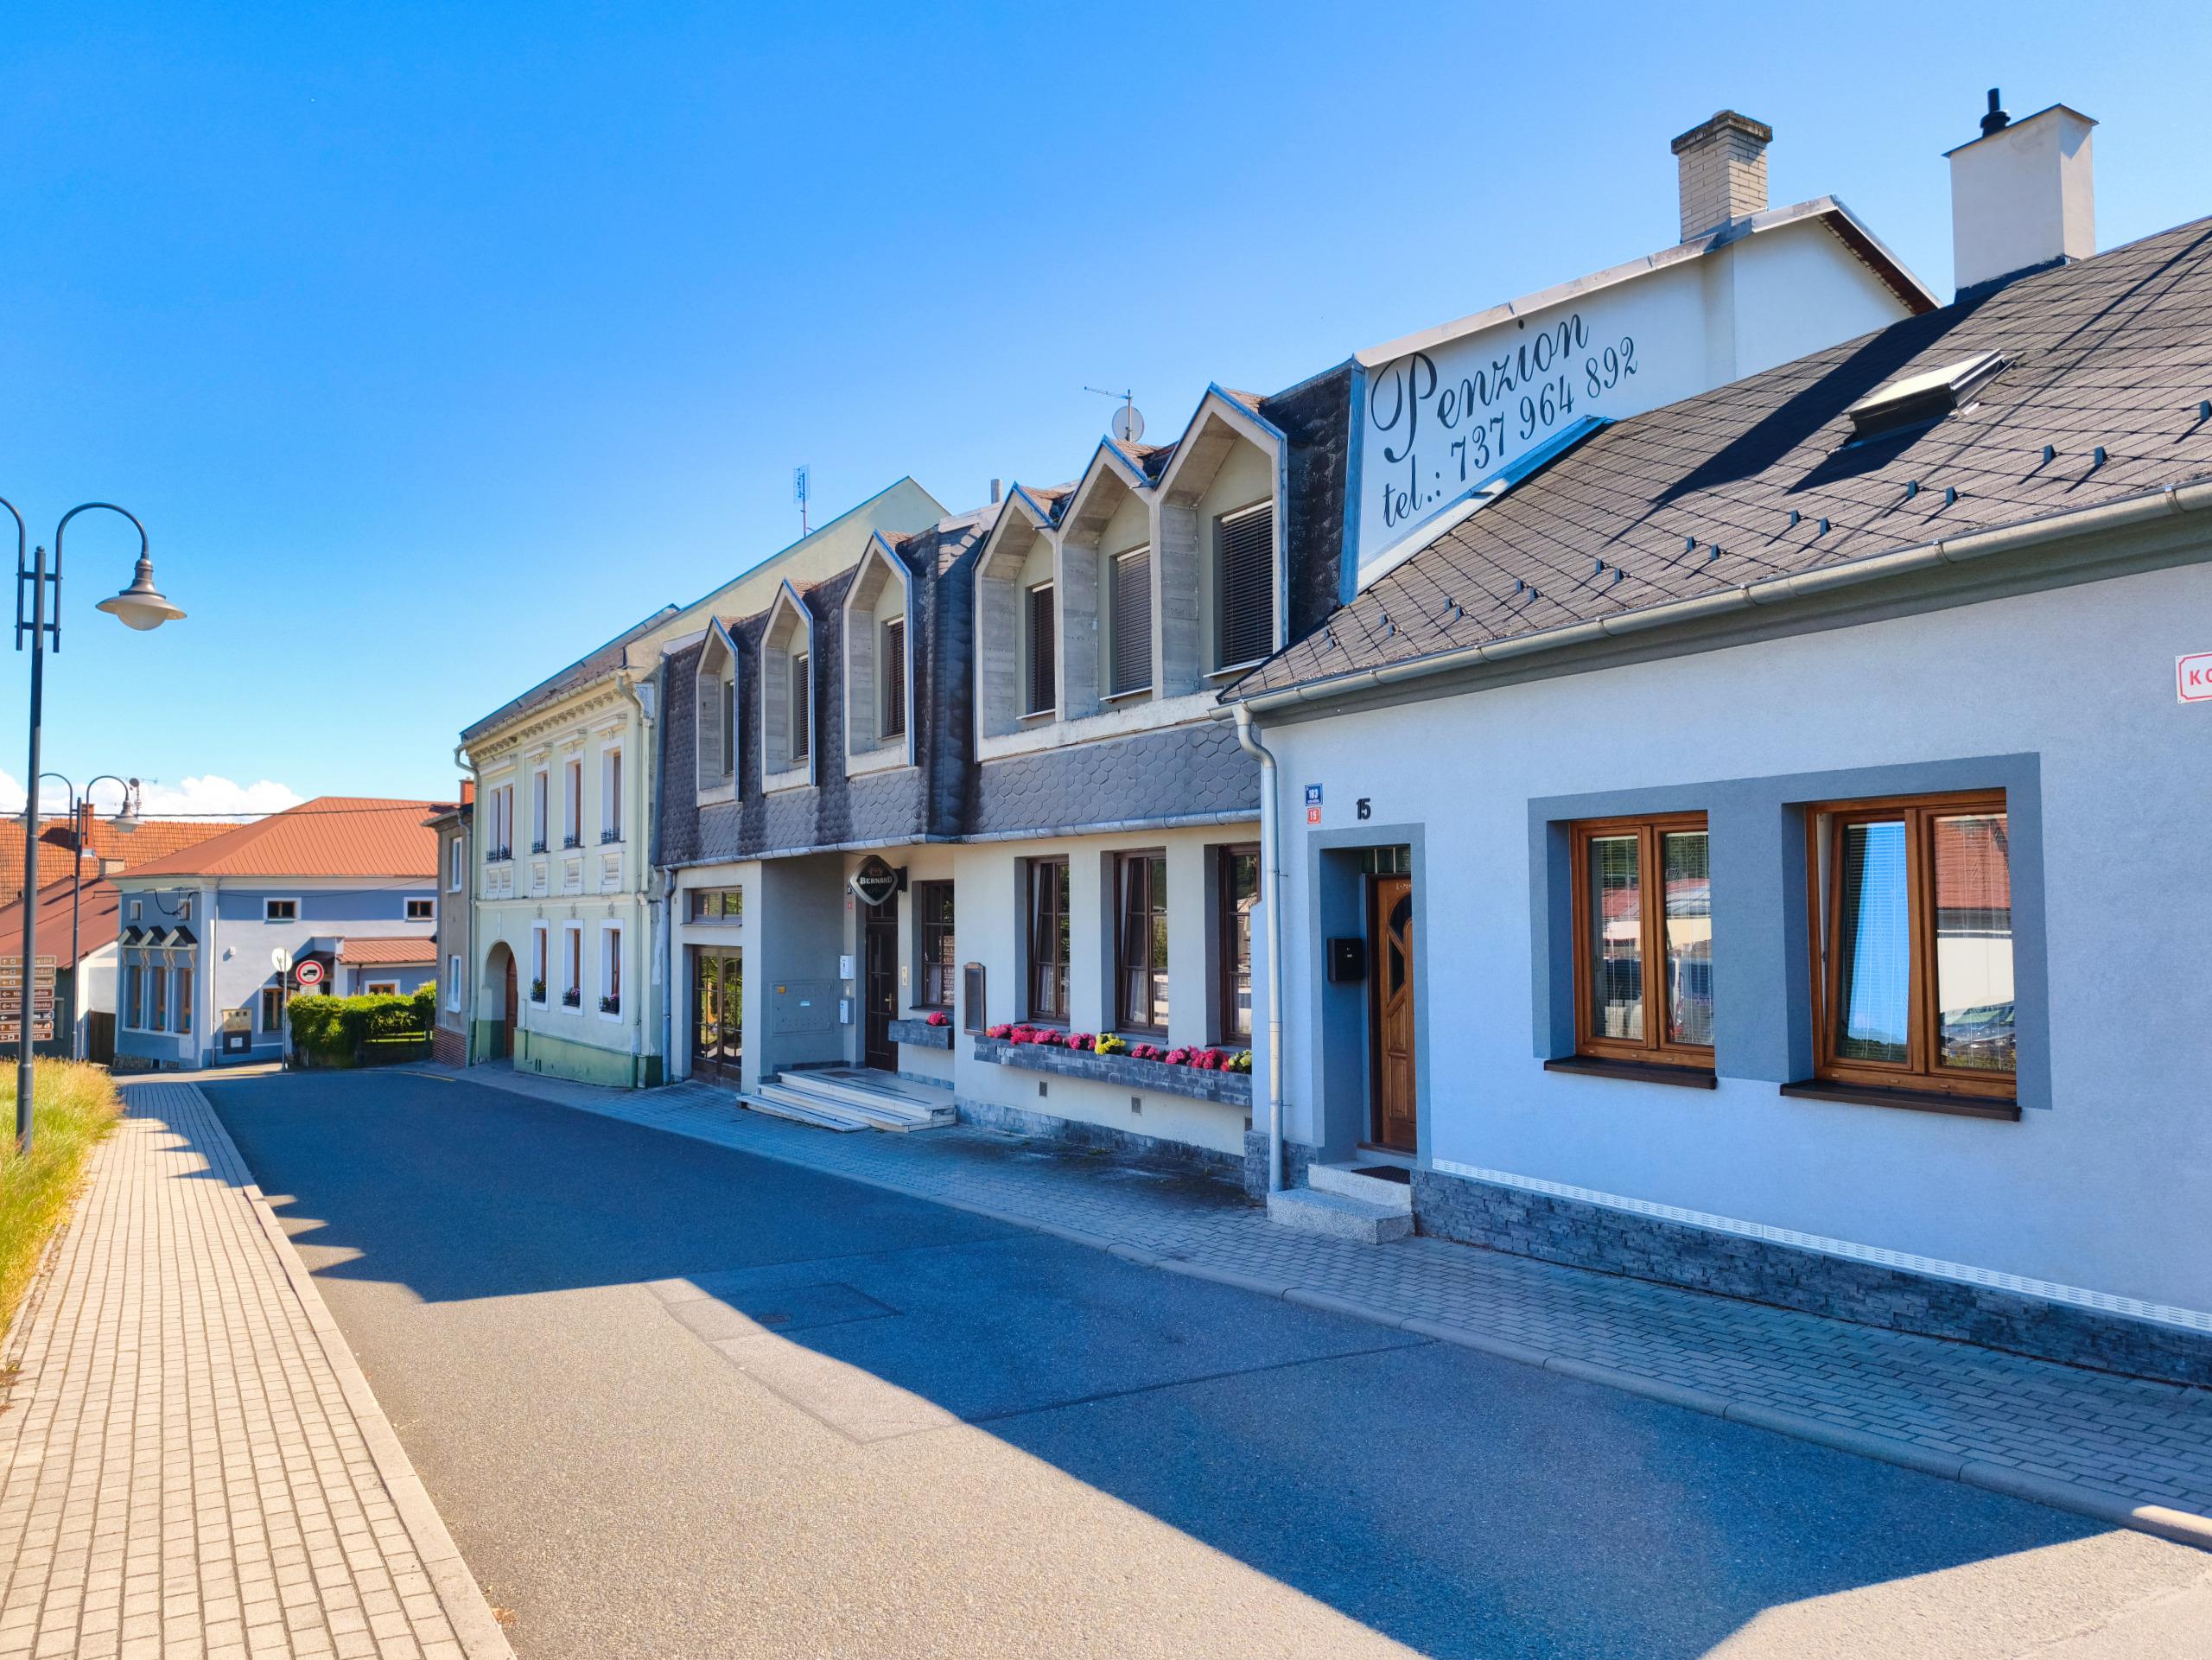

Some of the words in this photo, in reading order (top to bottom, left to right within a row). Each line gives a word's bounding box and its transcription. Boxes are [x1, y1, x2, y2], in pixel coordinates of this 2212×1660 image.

[1371, 314, 1589, 463] Penzion
[1382, 455, 1441, 527] tel.:
[1451, 411, 1504, 481] 737
[1520, 375, 1574, 440] 964
[1586, 337, 1638, 398] 892
[1357, 798, 1371, 820] 15
